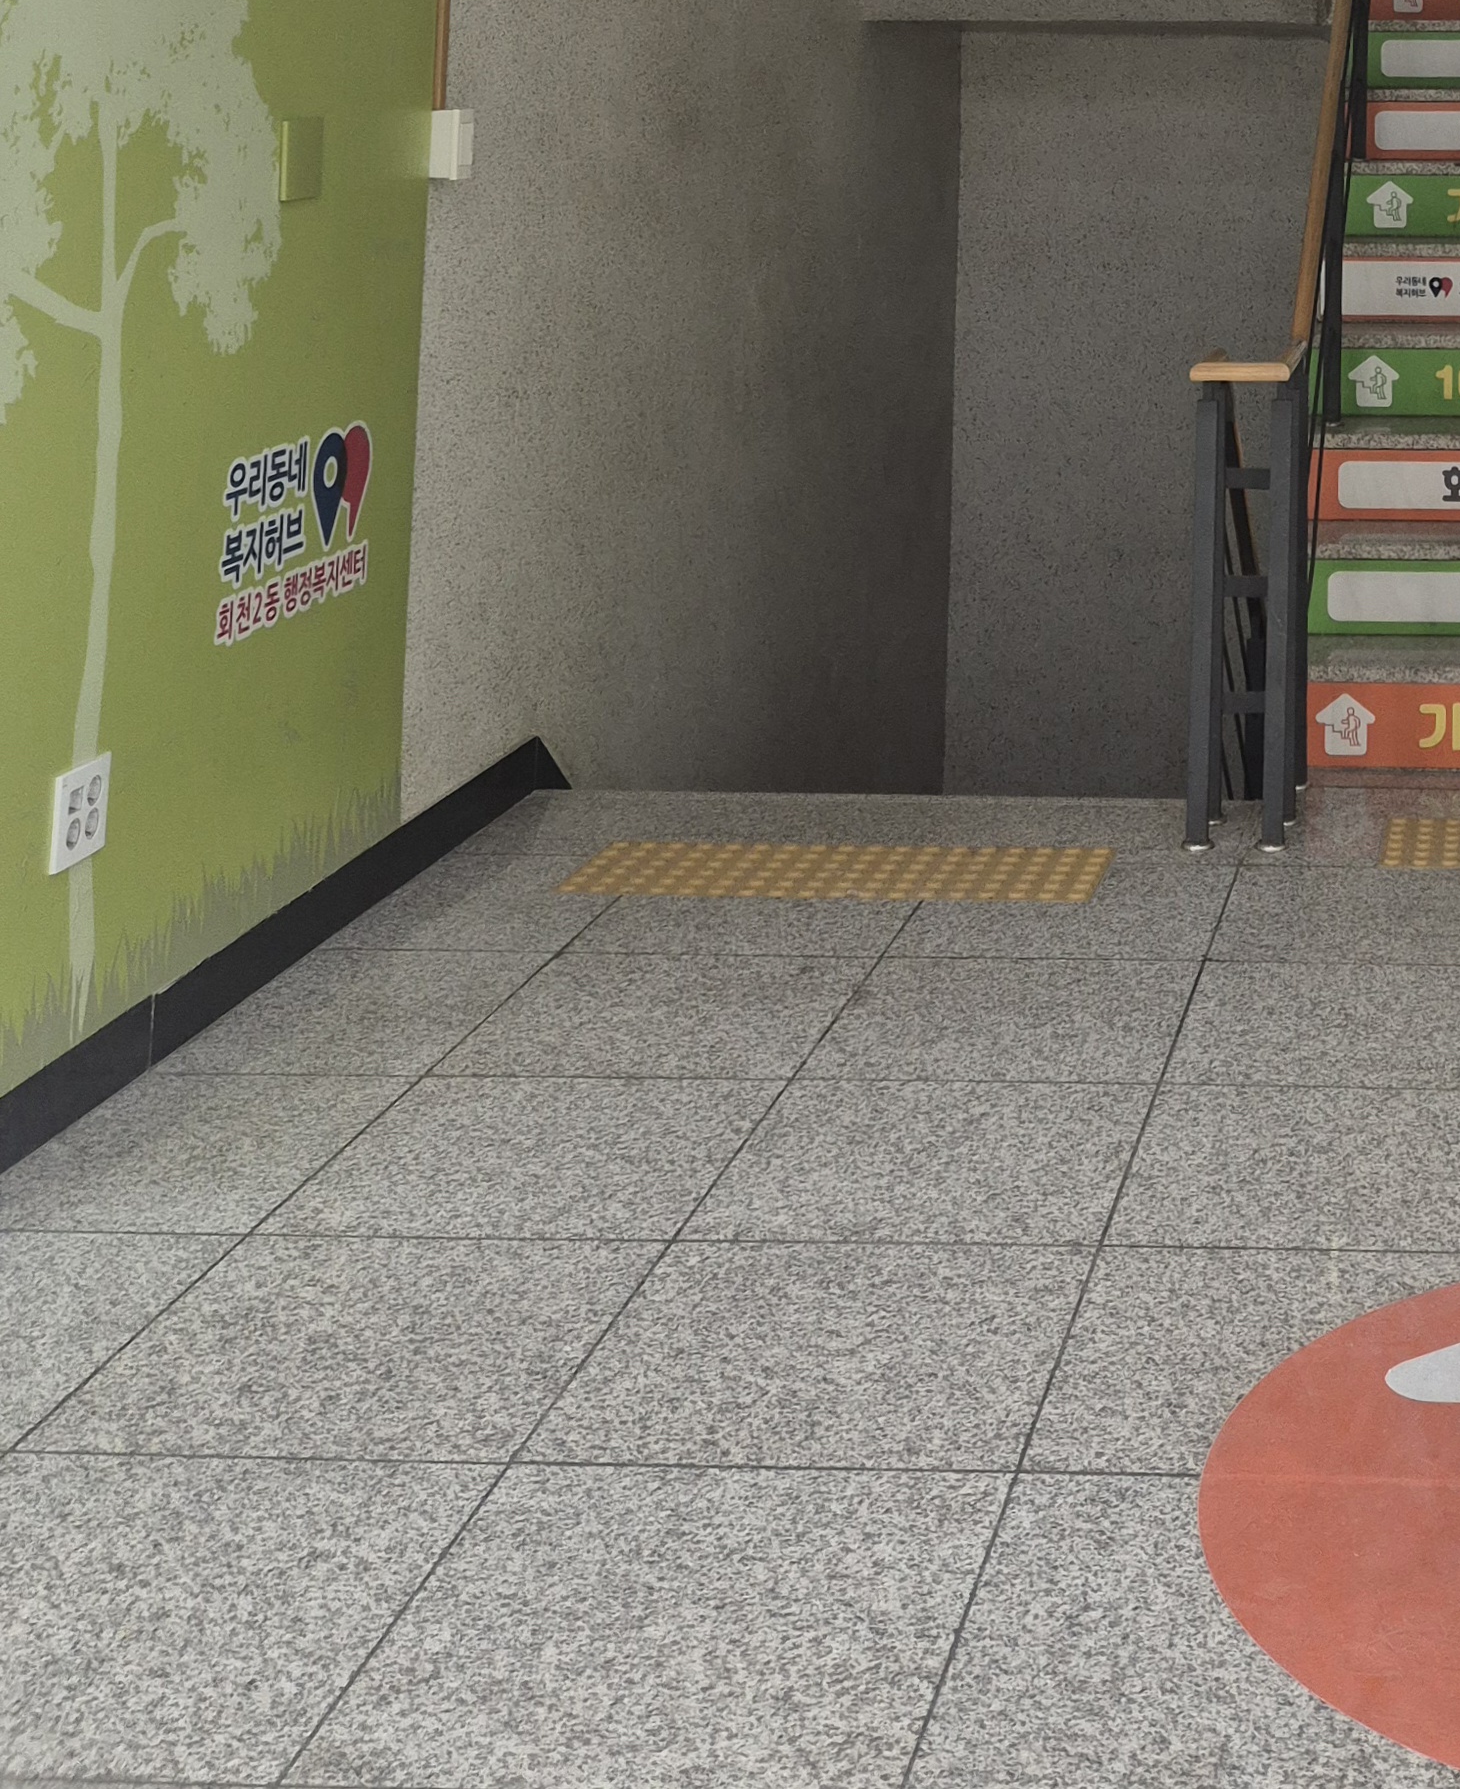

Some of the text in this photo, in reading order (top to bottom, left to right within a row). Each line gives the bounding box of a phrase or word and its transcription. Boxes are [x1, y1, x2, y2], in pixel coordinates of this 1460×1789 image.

[225, 440, 309, 517] 우리동네
[221, 509, 305, 584] 복지허브
[216, 543, 367, 641] 회천2동 행정복지센터
